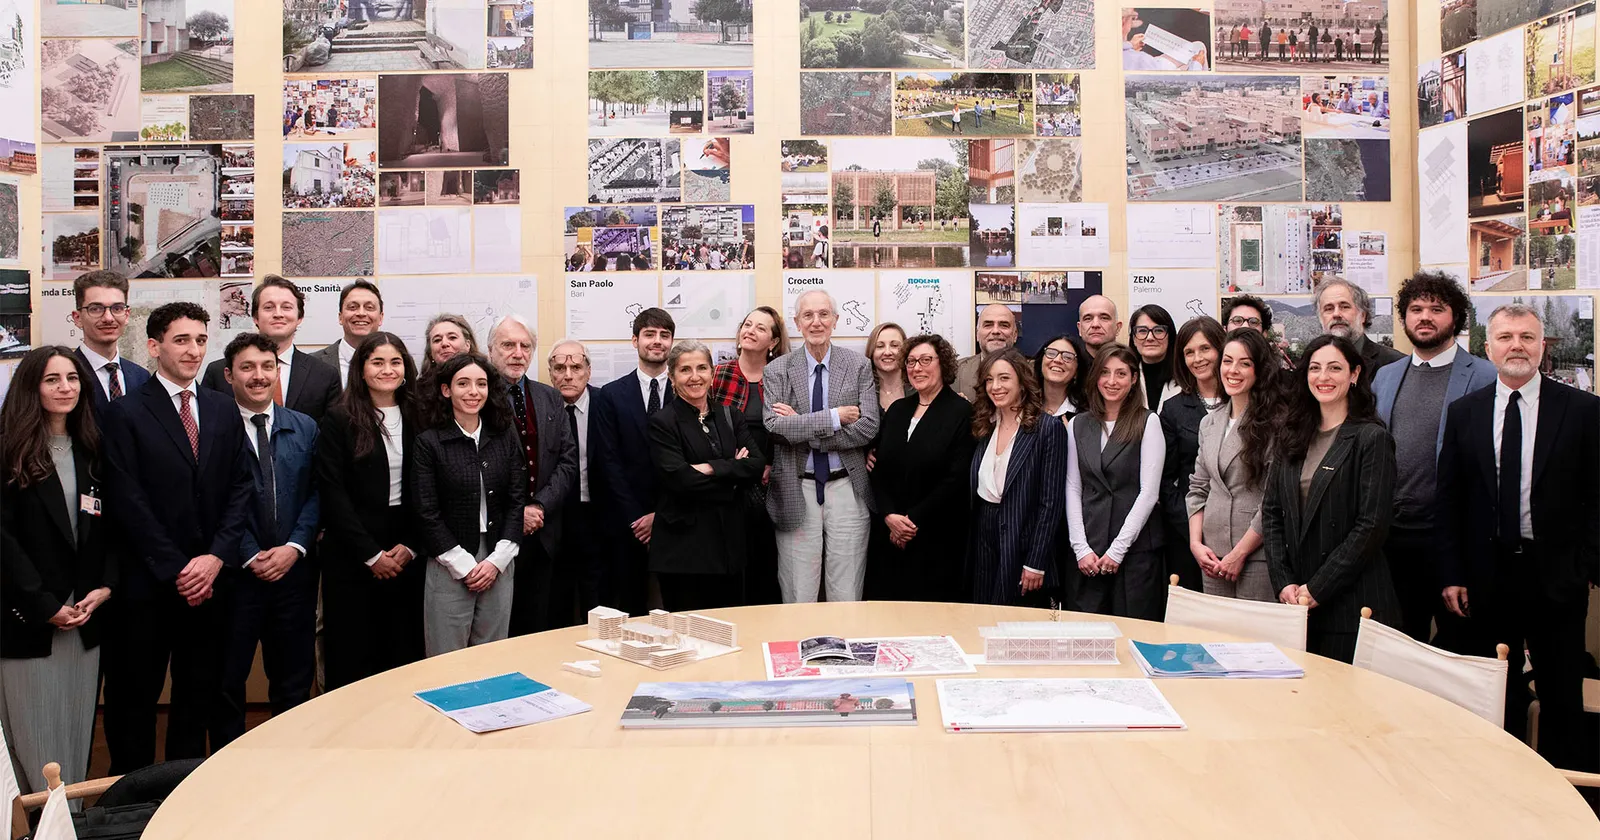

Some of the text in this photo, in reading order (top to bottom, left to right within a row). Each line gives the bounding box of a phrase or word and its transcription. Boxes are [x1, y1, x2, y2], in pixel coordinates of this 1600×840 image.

[570, 279, 614, 288] San Paolo
[788, 277, 824, 285] Crocetta
[1133, 276, 1155, 284] ZEN2
[313, 283, 341, 293] Sanità
[570, 290, 585, 298] Bari
